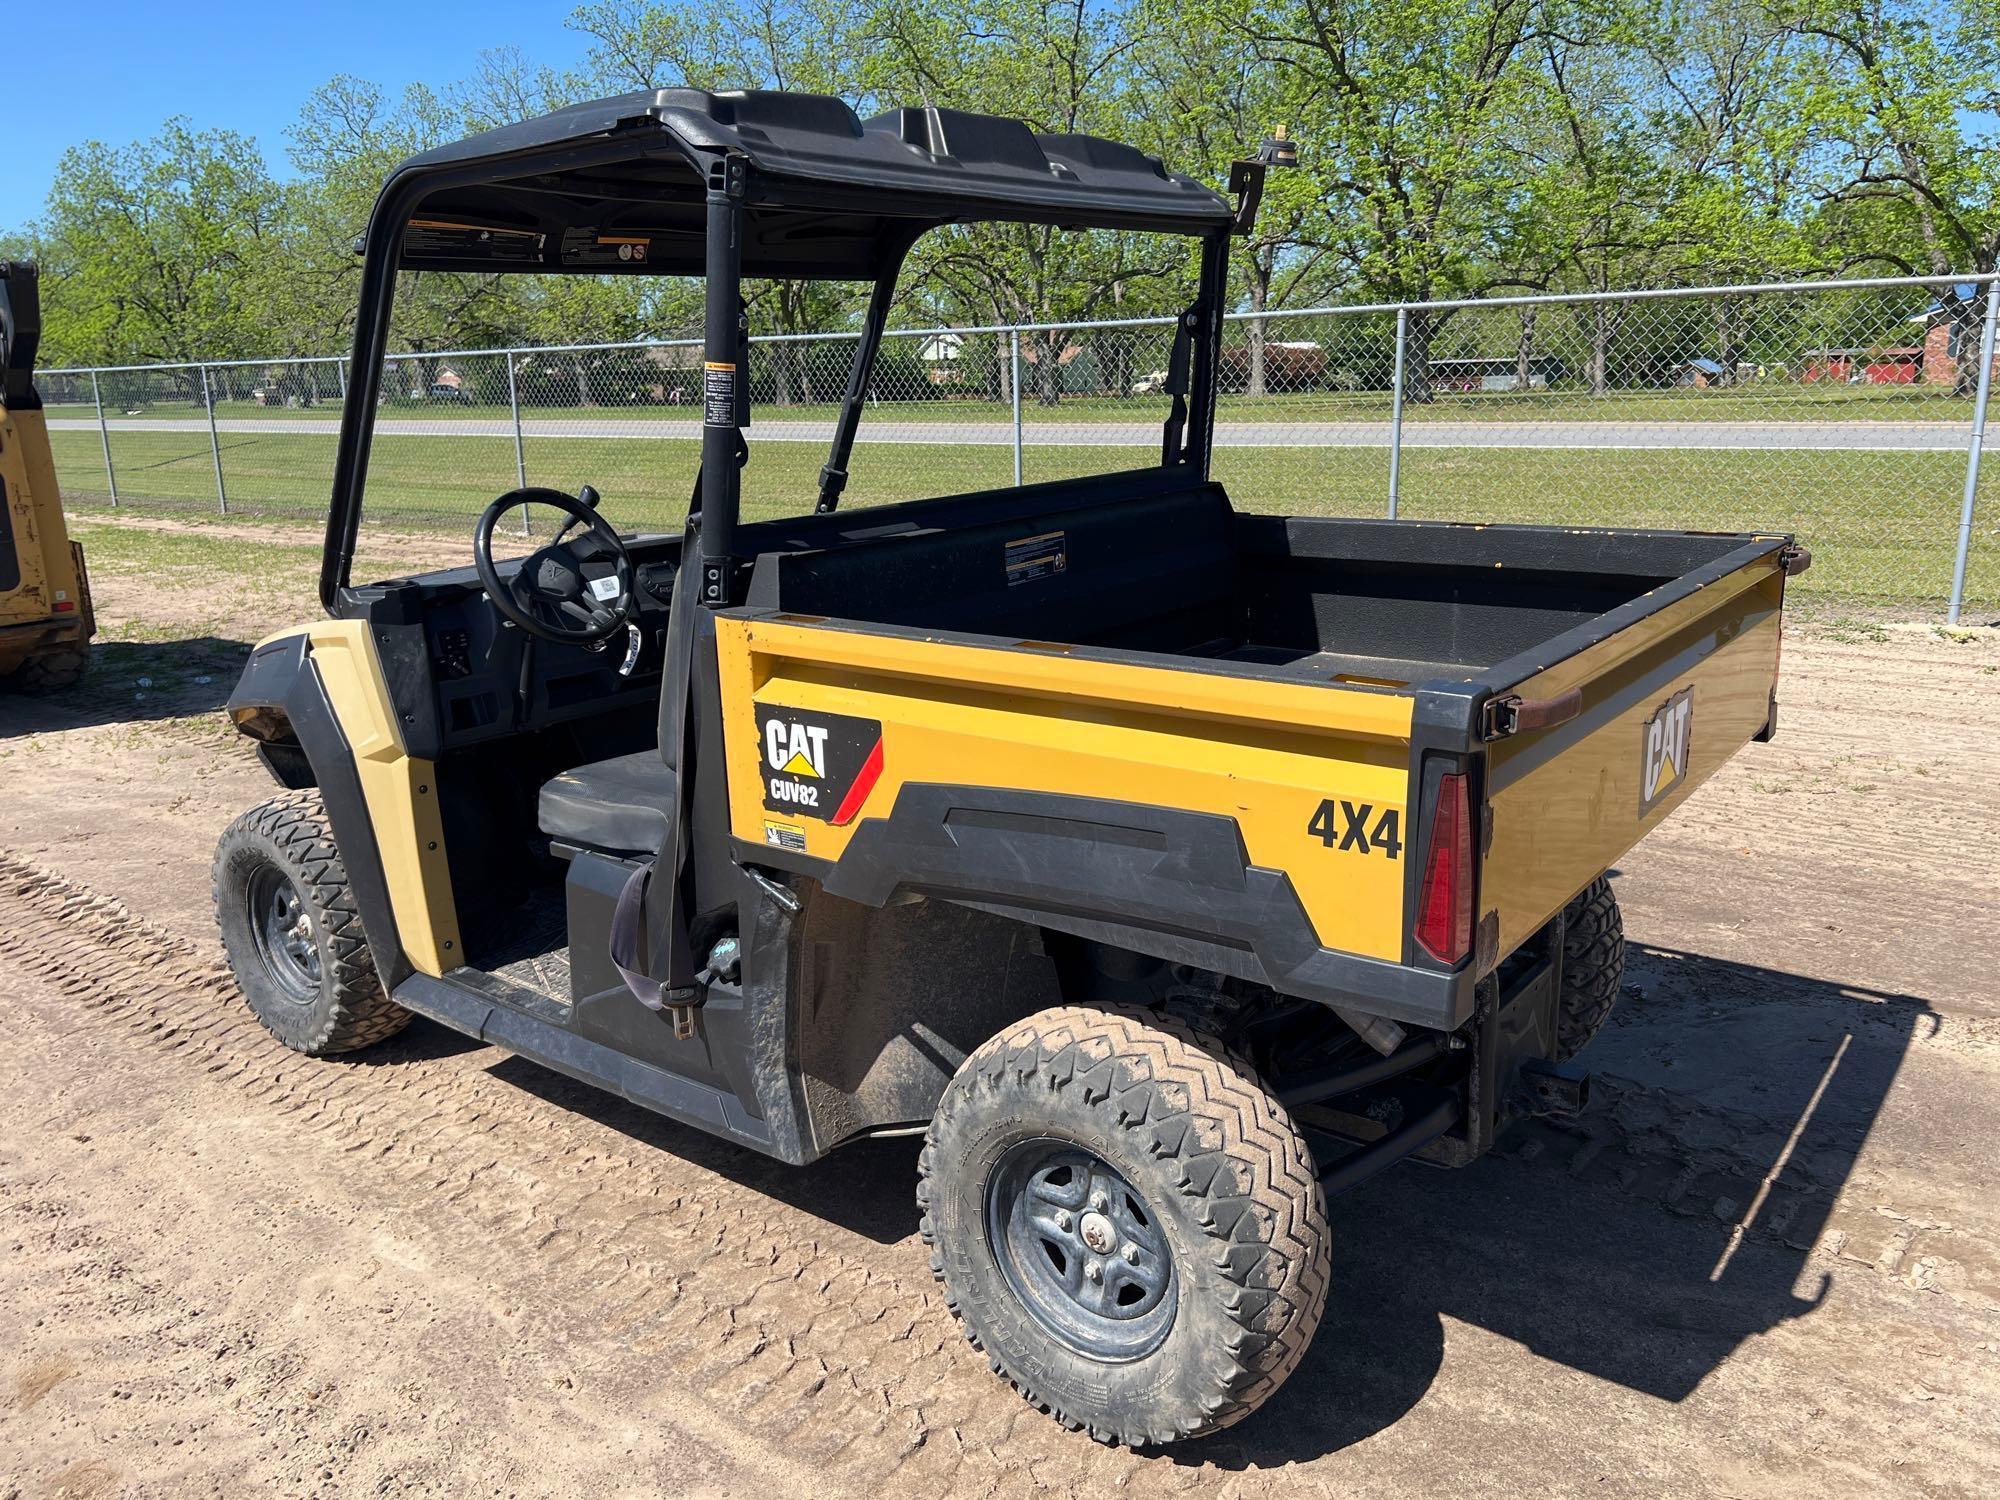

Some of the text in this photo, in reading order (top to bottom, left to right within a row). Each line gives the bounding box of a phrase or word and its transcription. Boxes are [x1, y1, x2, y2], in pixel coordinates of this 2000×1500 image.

[765, 719, 828, 779] CAT
[1646, 698, 1689, 802] CAT
[771, 778, 819, 807] CUV82
[1307, 798, 1403, 860] 4X4
